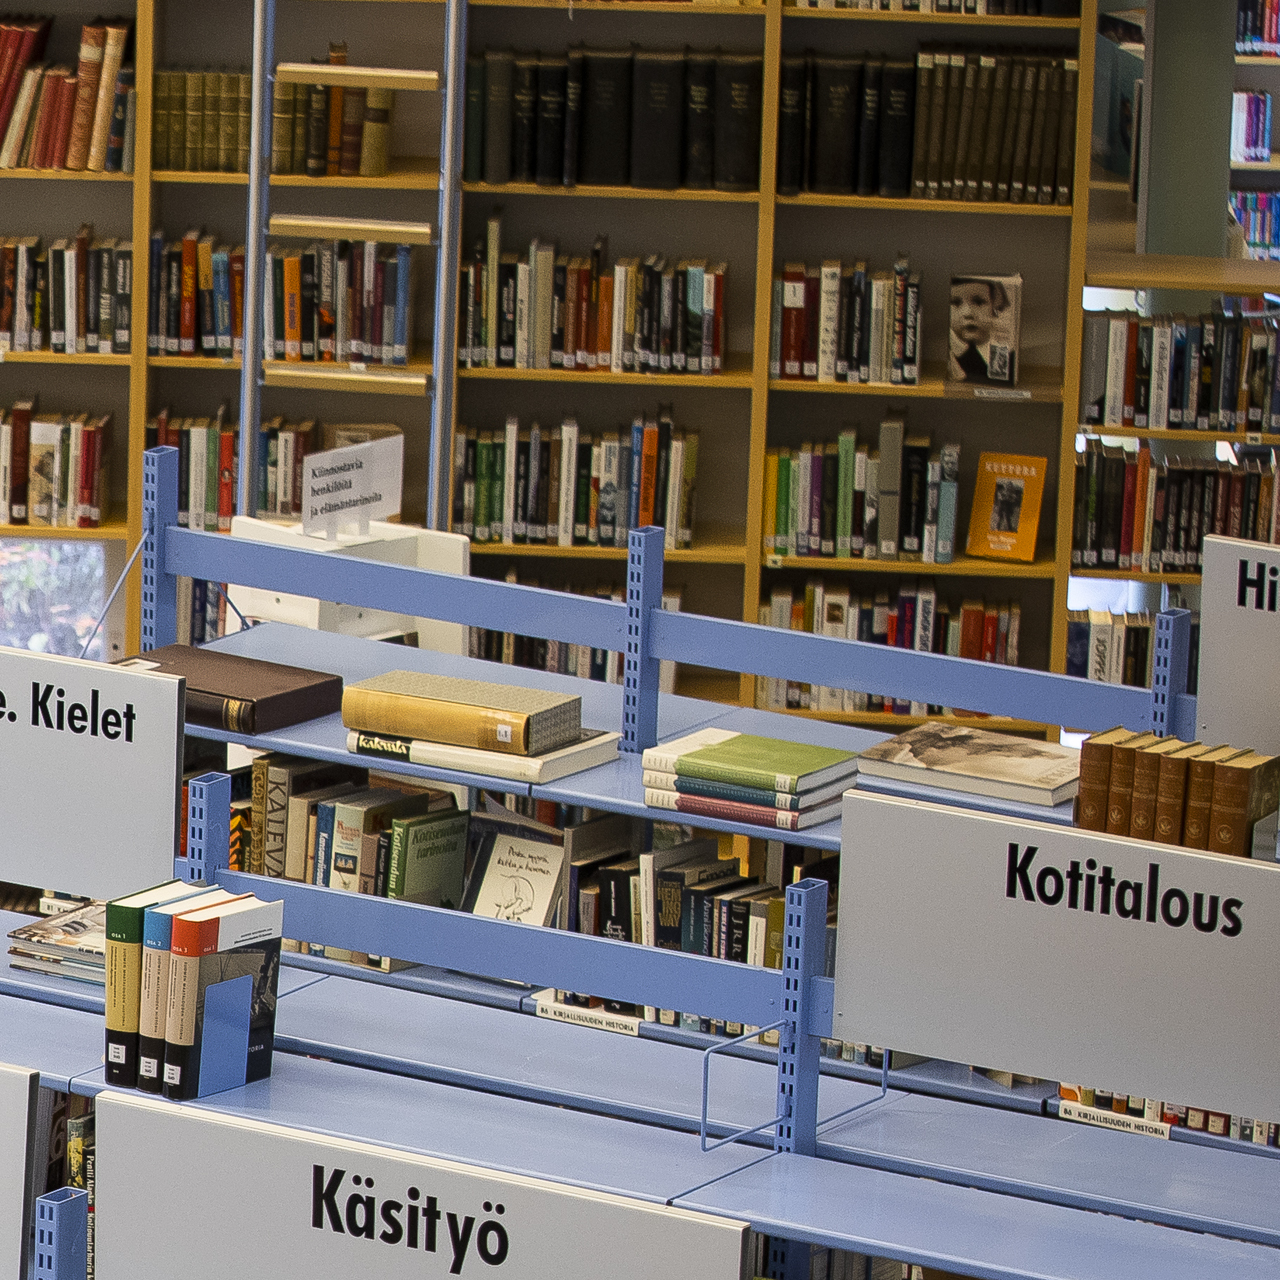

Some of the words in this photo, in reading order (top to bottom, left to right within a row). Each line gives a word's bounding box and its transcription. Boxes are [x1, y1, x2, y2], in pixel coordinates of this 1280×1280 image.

[1237, 559, 1280, 612] Hi
[31, 681, 136, 743] Kielet
[1006, 842, 1244, 937] Kotitalous
[111, 932, 121, 940] OSA
[657, 913, 681, 928] WAY
[552, 1008, 604, 1028] KIRJALLISUUDEN
[605, 1019, 635, 1034] HISTORIA
[1077, 1110, 1132, 1130] KIRJALLISUUDEN
[1133, 1123, 1165, 1138] HISTORIA
[312, 1164, 509, 1275] Käsityö
